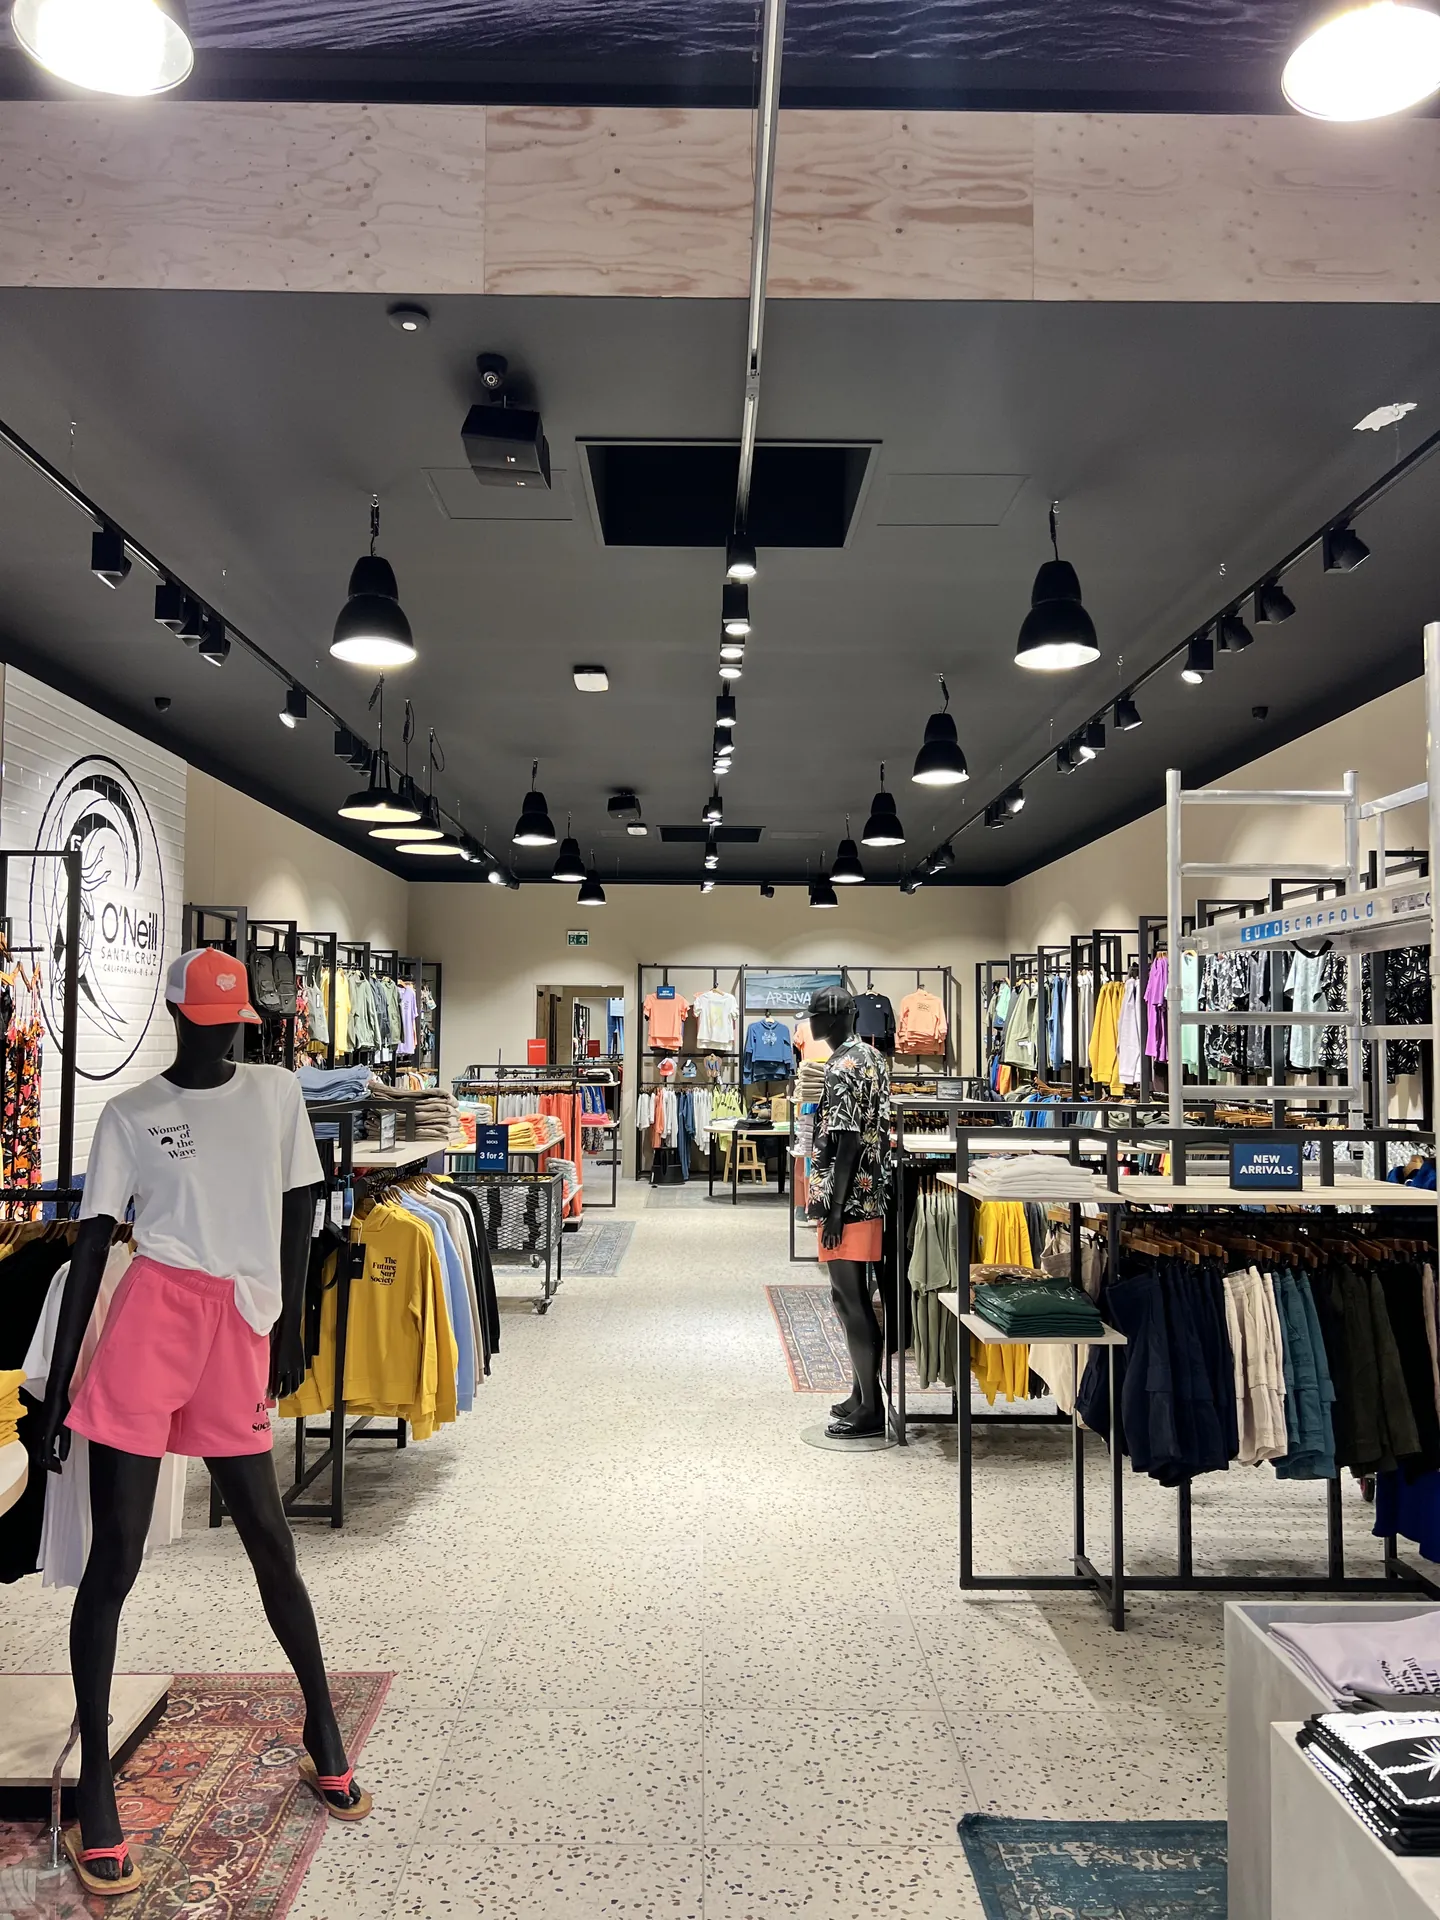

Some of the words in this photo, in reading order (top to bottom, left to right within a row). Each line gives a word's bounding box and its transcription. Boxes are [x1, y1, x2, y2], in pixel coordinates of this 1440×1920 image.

[102, 902, 158, 951] O'Neill
[101, 946, 130, 963] SANTA
[134, 951, 157, 966] CRUZ
[147, 1123, 190, 1137] Women
[179, 1129, 191, 1139] of
[176, 1139, 195, 1149] the
[167, 1148, 197, 1159] Wave
[479, 1151, 486, 1160] 3
[486, 1151, 497, 1160] for
[498, 1151, 504, 1160] 2
[1253, 1154, 1281, 1164] NEW
[1239, 1165, 1294, 1175] ARRIVALS
[384, 1256, 397, 1265] The
[372, 1261, 397, 1272] Future
[380, 1269, 397, 1279] Surf
[370, 1275, 394, 1286] Society
